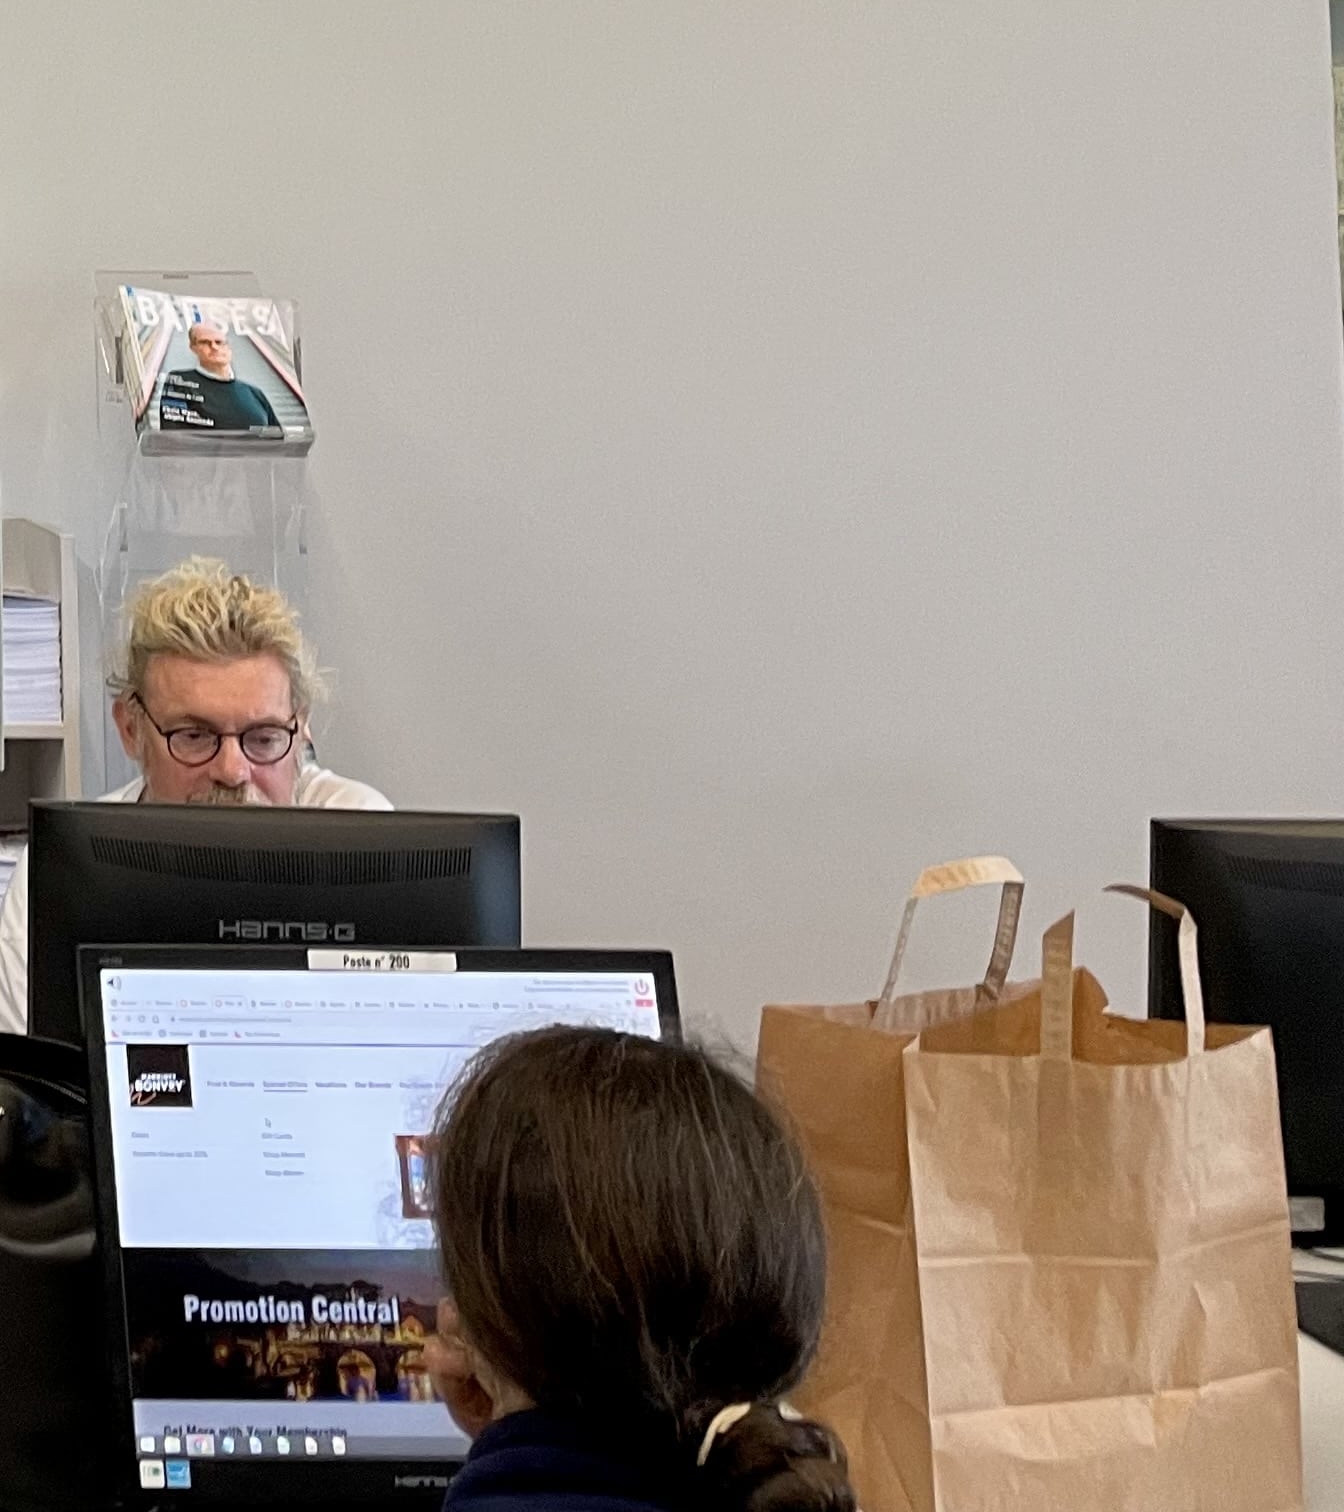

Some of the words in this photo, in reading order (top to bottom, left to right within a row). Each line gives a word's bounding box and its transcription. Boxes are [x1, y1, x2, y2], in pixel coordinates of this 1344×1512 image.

[343, 954, 371, 968] Poste
[389, 954, 410, 969] 200
[183, 1293, 305, 1323] Promotion
[311, 1294, 400, 1325] Central
